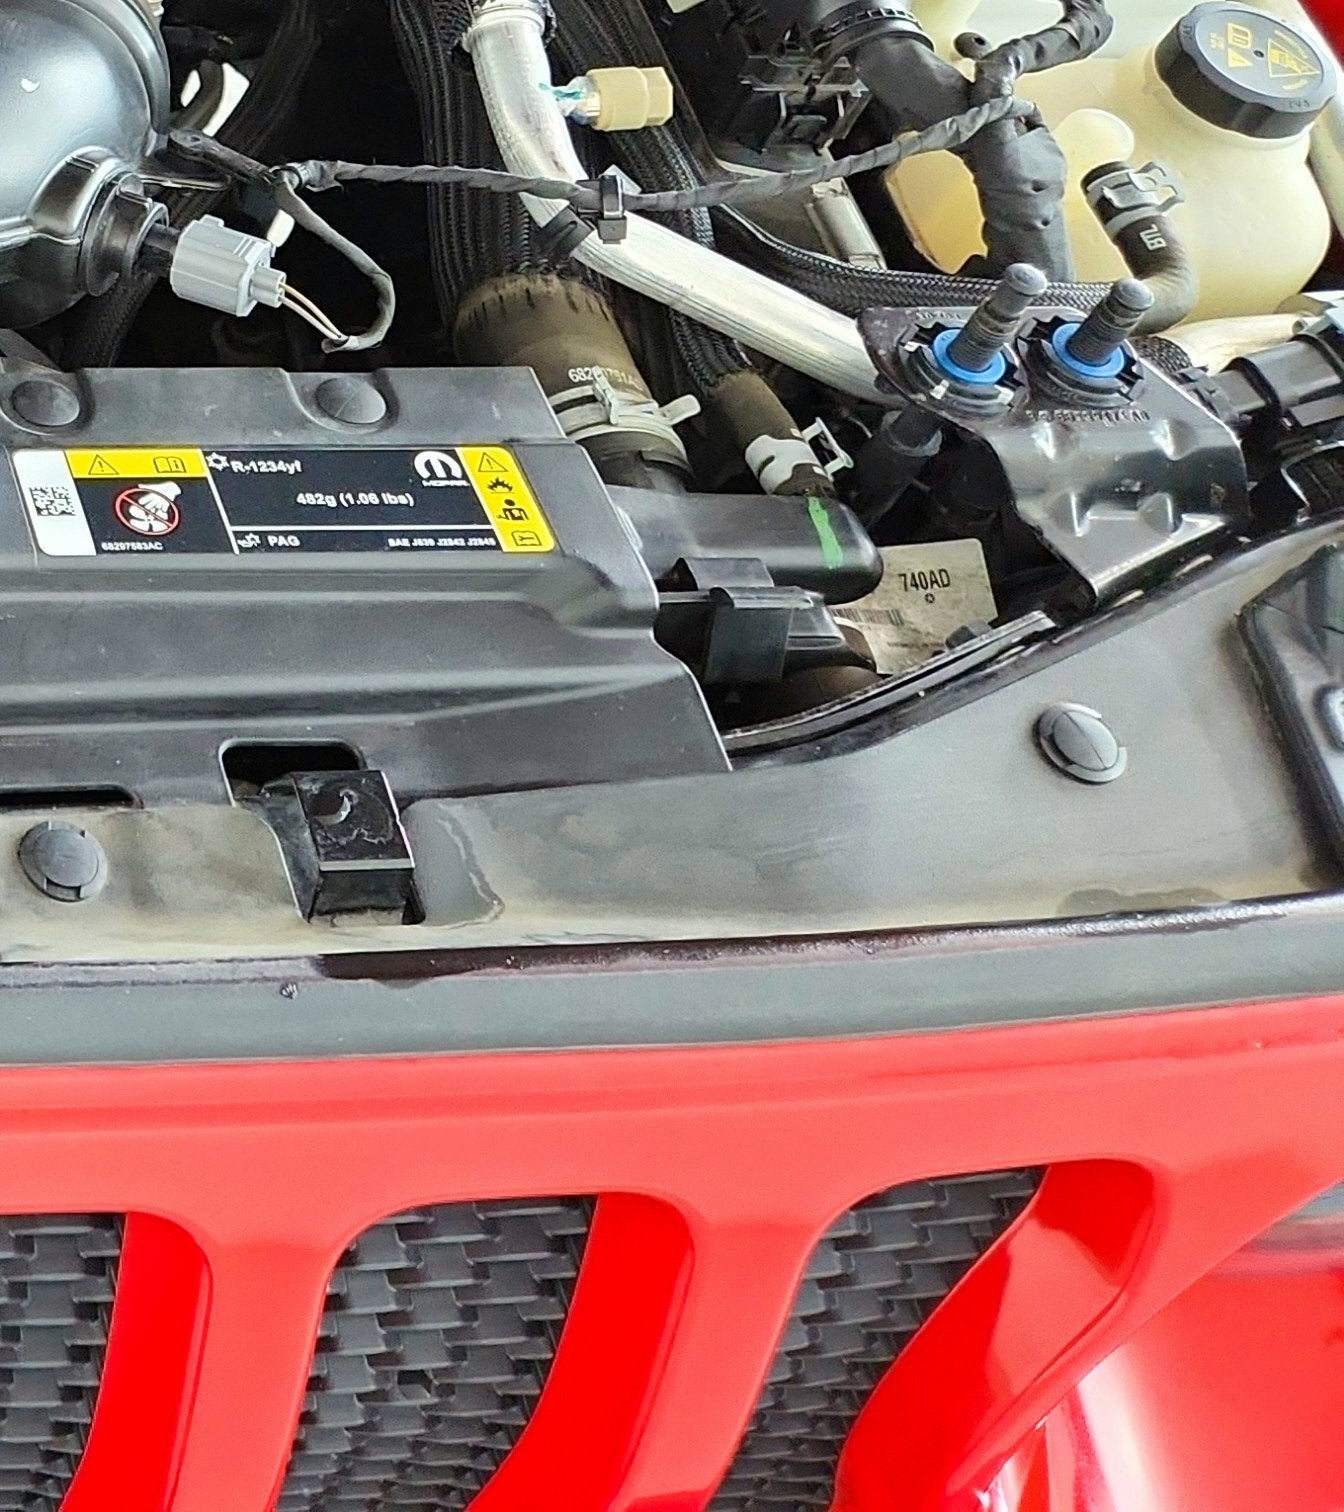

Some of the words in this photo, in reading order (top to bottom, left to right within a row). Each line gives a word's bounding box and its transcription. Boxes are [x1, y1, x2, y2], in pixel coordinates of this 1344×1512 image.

[230, 459, 302, 475] R-1234yf
[296, 492, 337, 508] 482g
[340, 492, 381, 508] (1.06
[382, 492, 415, 507] lbs)
[267, 535, 301, 548] PAG
[898, 568, 951, 592] 740AD
